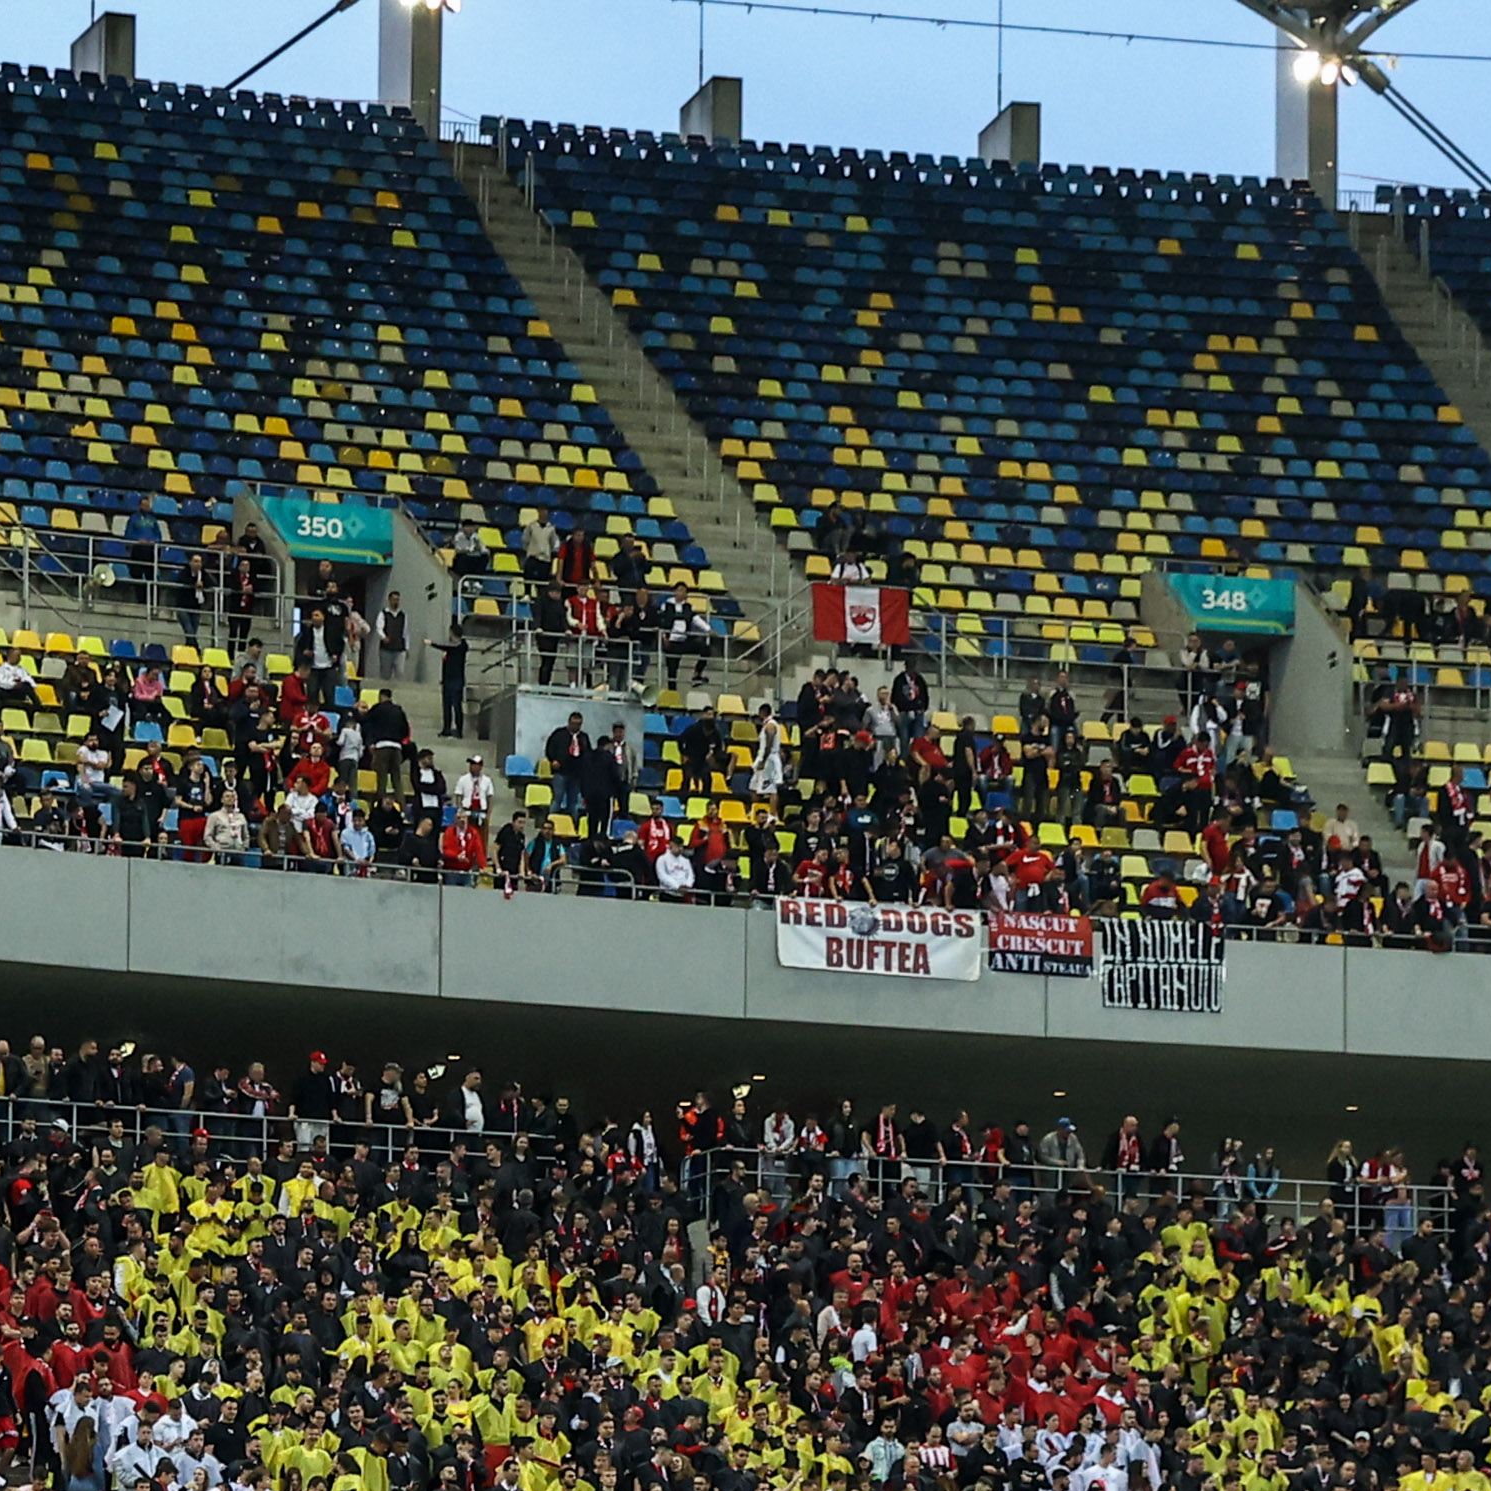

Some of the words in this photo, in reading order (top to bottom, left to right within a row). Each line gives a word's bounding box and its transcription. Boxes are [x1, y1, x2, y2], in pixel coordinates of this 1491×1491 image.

[296, 515, 344, 540] 350
[1200, 588, 1247, 612] 348
[780, 900, 848, 929] RED
[880, 909, 976, 939] DOGS
[825, 936, 931, 975] BUFTEA
[997, 934, 1084, 956] CRESCUT
[990, 952, 1042, 972] ANTI
